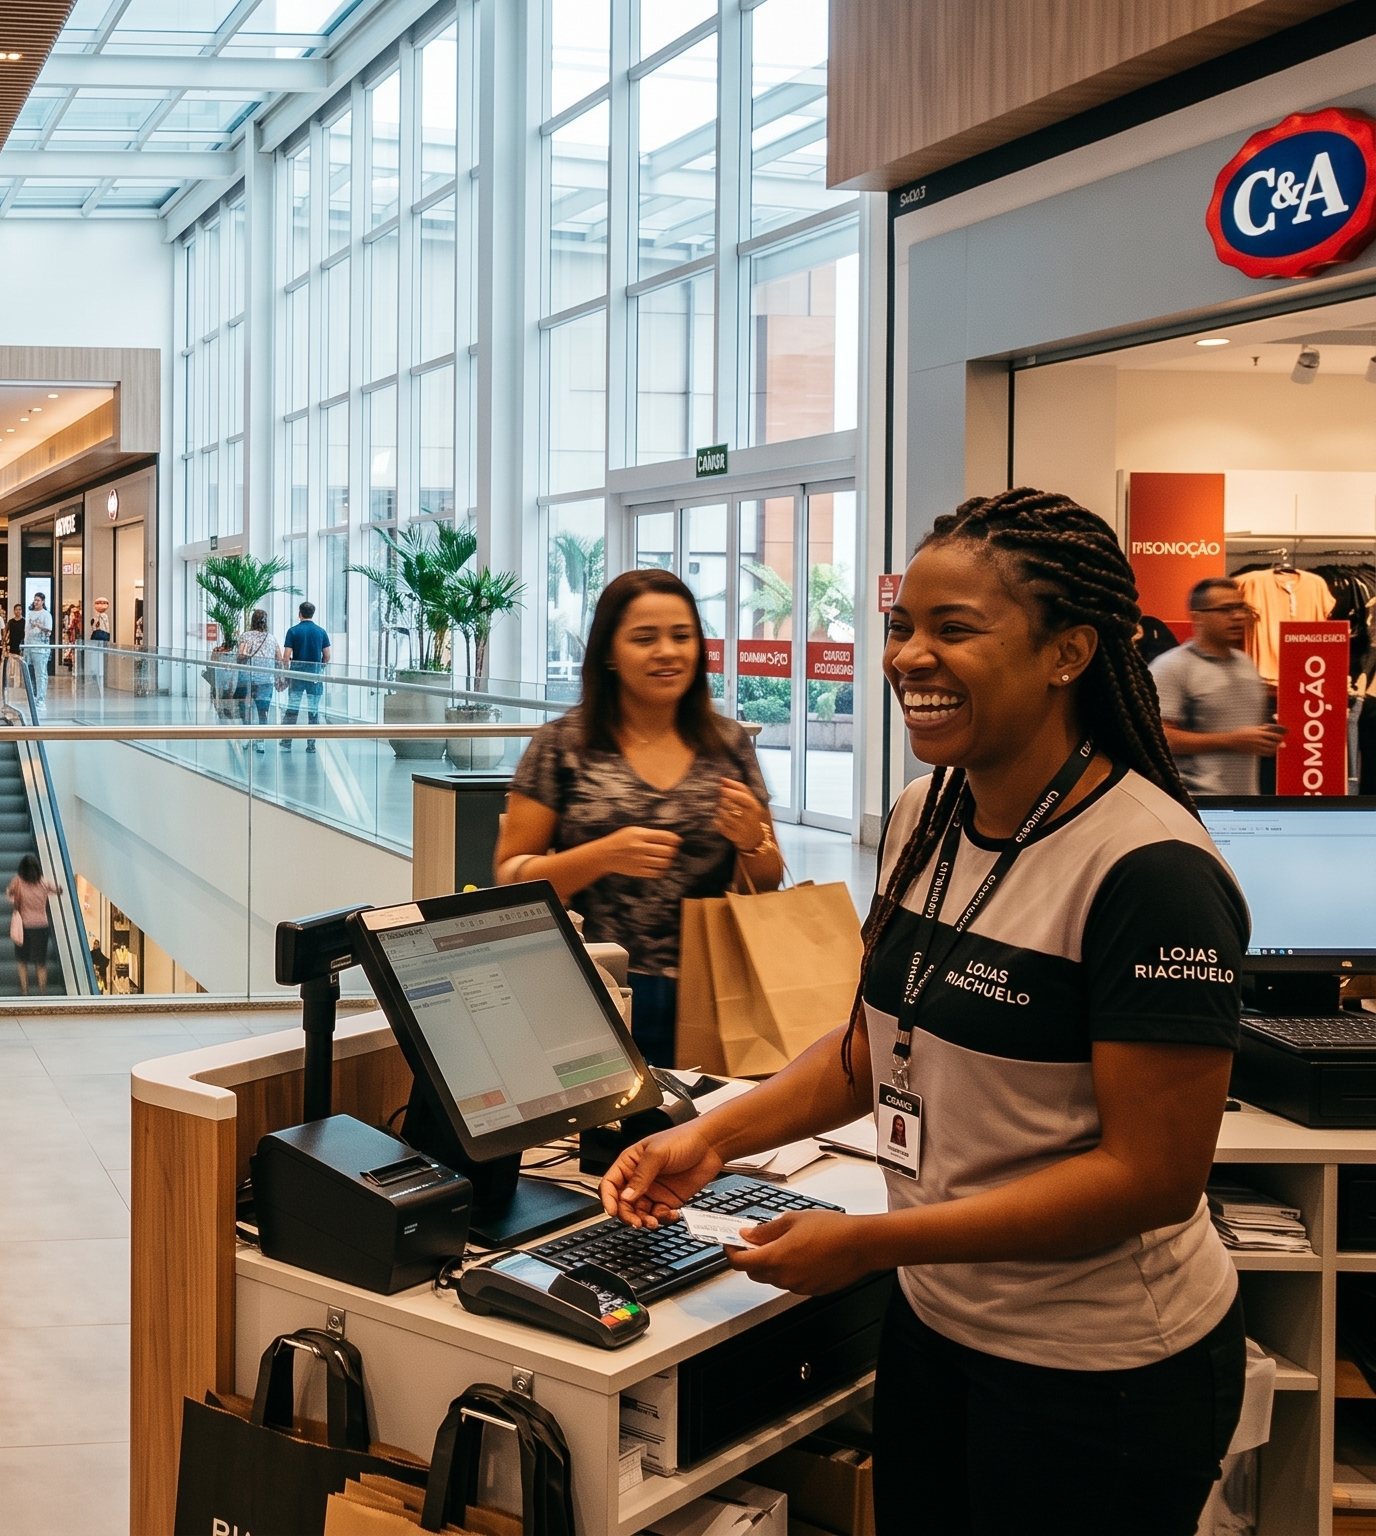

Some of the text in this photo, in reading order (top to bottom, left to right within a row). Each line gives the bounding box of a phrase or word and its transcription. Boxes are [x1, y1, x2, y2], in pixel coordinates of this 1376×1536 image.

[1232, 151, 1349, 237] C&A
[1299, 655, 1332, 796] OMOÇÃO
[1160, 947, 1218, 964] LOJAS
[965, 960, 1009, 984] LOJAS
[1135, 965, 1234, 984] RIACHUELO
[945, 970, 1030, 1005] RIACHUELO
